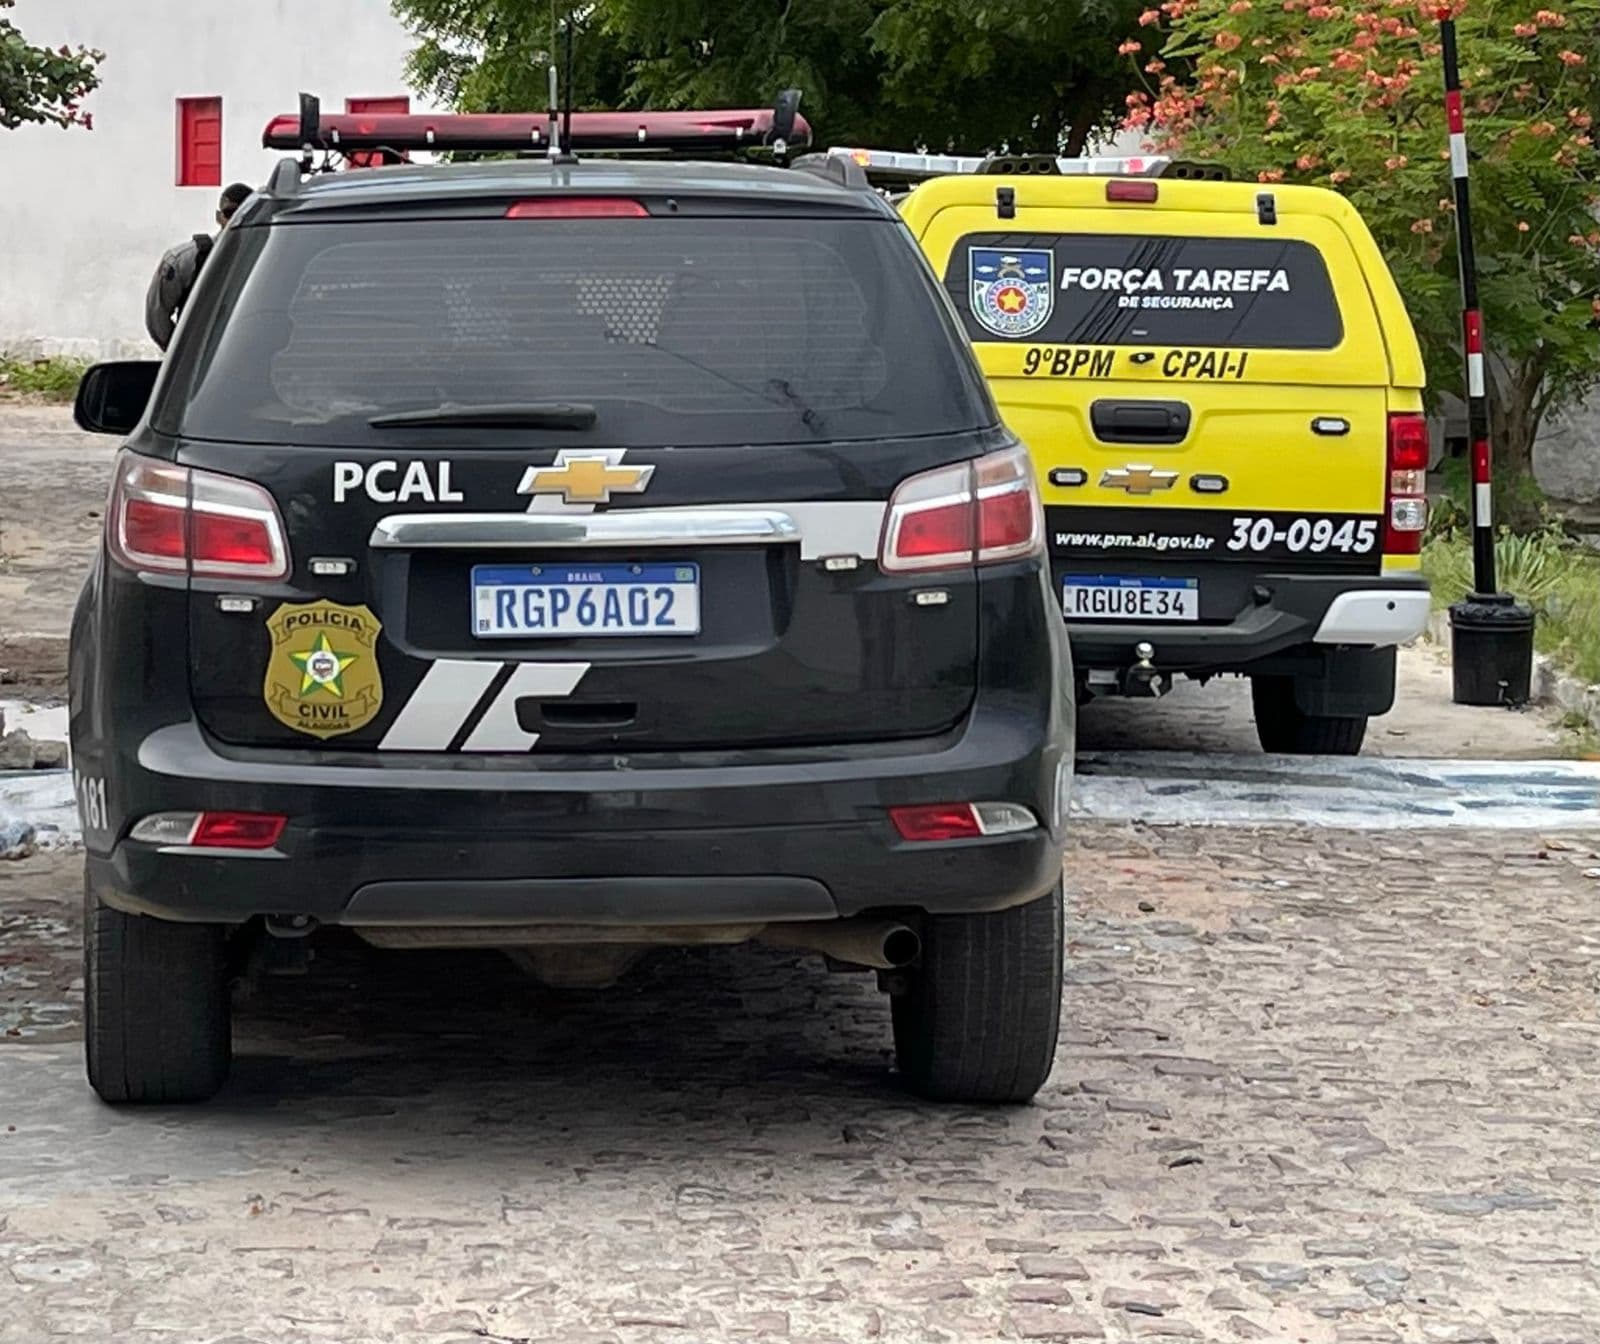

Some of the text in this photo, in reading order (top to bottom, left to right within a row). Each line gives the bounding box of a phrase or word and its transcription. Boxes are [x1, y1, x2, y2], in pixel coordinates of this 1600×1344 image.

[1060, 268, 1290, 294] FORÇA TAREFA
[1118, 296, 1233, 310] DE SEGURANÇA
[1162, 350, 1249, 379] CPAI-I
[334, 461, 463, 502] PCAL
[1055, 531, 1215, 550] www.pm.al.gov.br
[1227, 517, 1378, 553] 30-0945
[495, 587, 676, 629] RGP6A02
[1075, 588, 1185, 616] RGU8E34
[286, 611, 363, 632] POLÍCIA
[298, 703, 350, 719] CIVIL
[82, 775, 108, 830] 181
